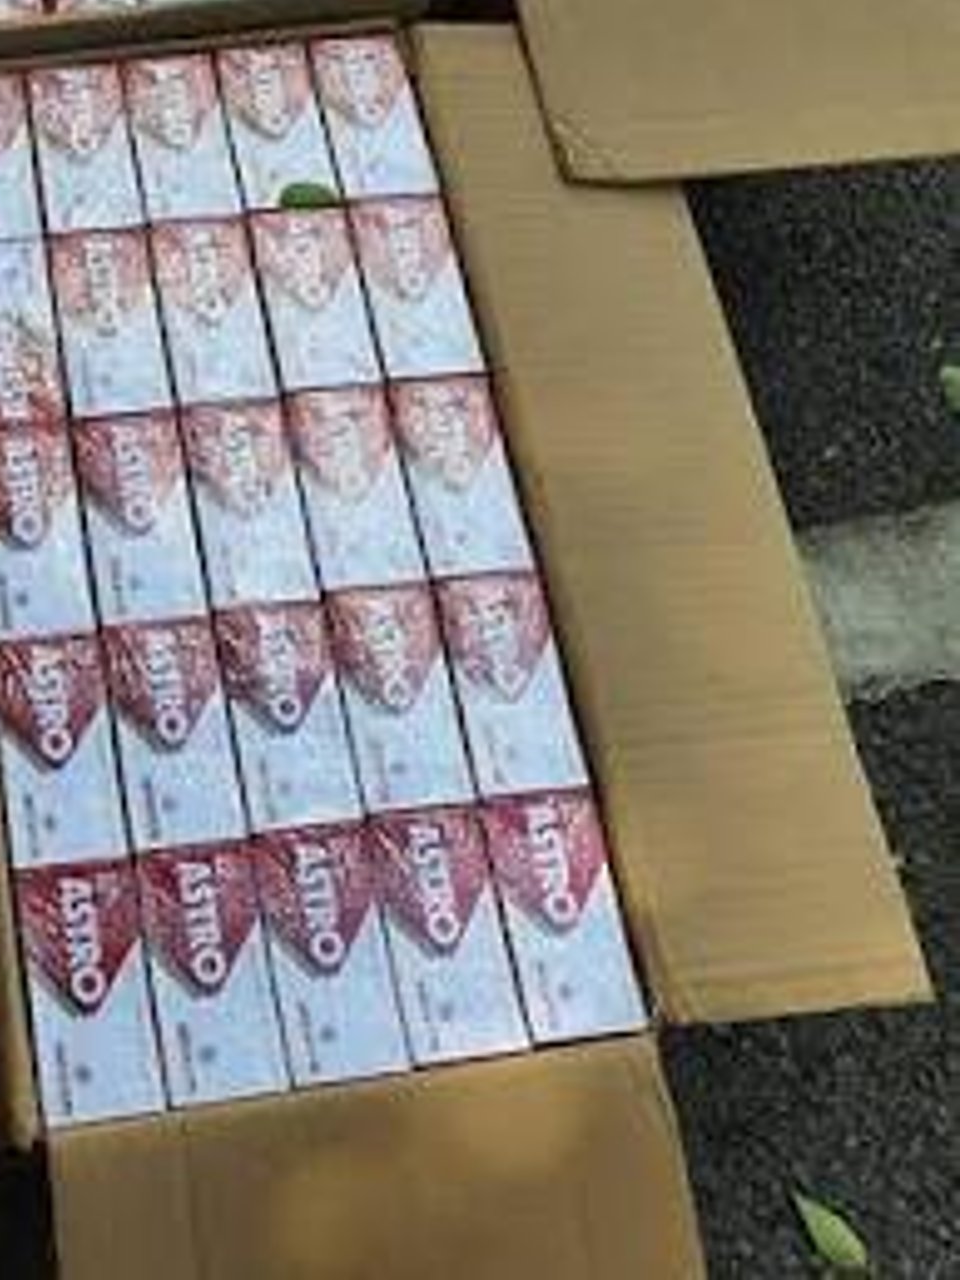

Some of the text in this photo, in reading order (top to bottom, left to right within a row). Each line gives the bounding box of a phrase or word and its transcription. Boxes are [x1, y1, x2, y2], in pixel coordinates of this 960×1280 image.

[31, 652, 72, 762] ASTRO
[145, 633, 187, 743] ASTRO
[261, 617, 300, 723] ASTRO
[296, 845, 343, 965] ASTRO
[410, 826, 458, 947] ASTRO
[528, 806, 572, 922] ASTRO
[60, 879, 104, 1002] ASTRO
[177, 862, 227, 985] ASTRO
